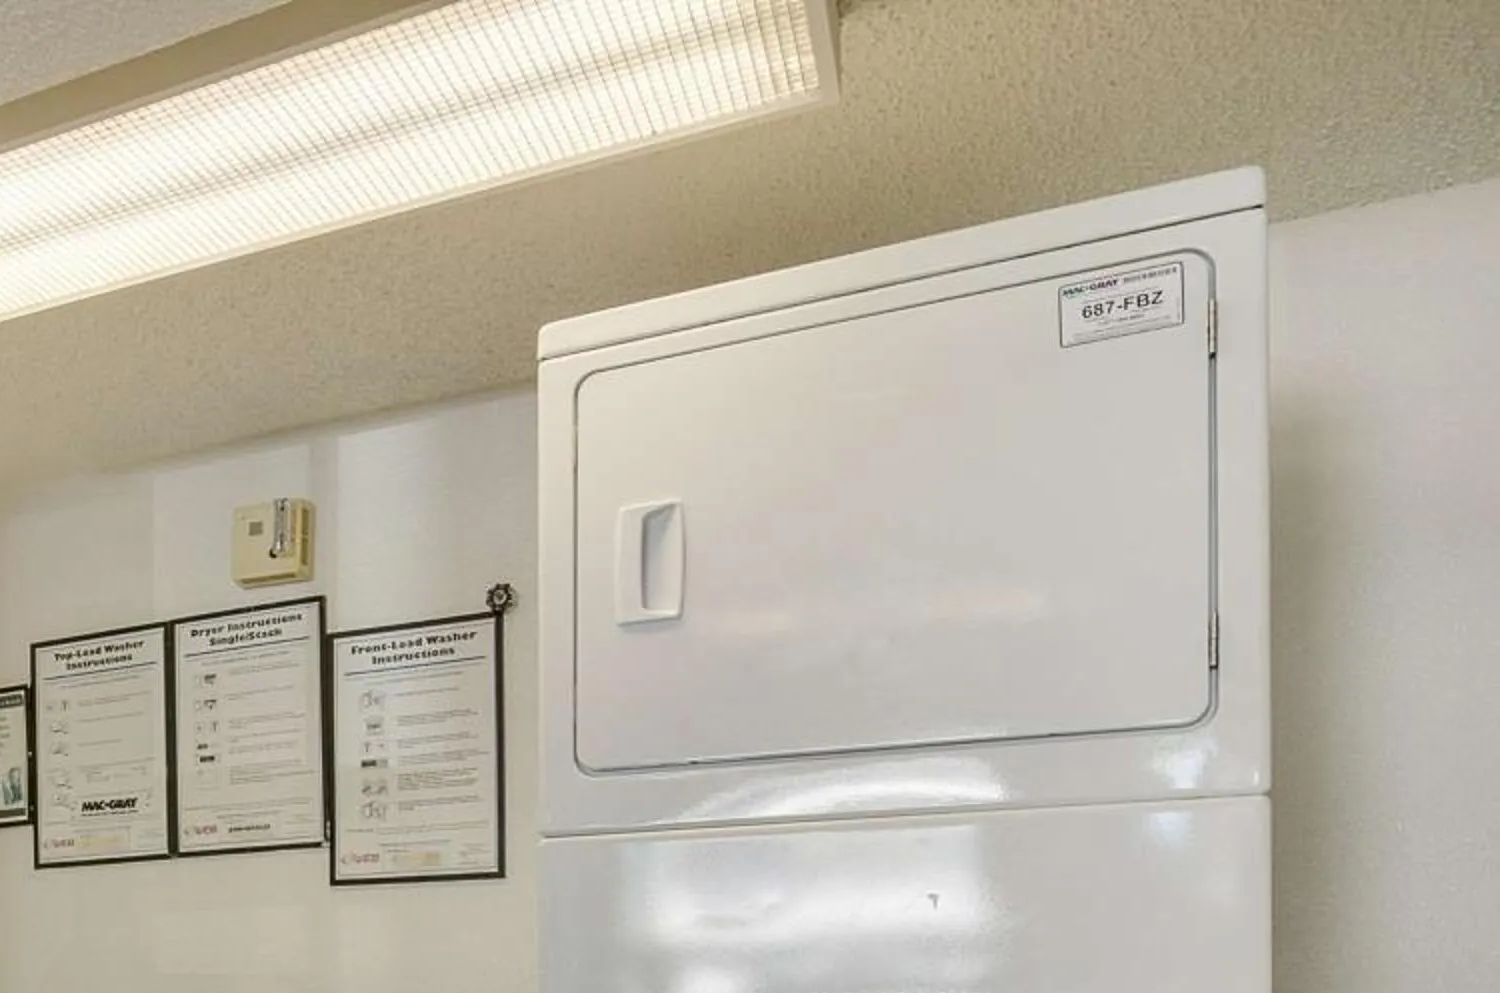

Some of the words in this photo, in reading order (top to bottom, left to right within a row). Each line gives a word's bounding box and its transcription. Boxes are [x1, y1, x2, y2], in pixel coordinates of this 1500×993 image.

[1082, 290, 1163, 319] 687-FBZ
[190, 625, 224, 638] Dryer
[227, 613, 302, 631] Instructions
[104, 640, 144, 653] Washer
[351, 637, 423, 655] Front-Load
[425, 631, 478, 645] Washer
[66, 653, 133, 671] Instructions
[372, 646, 455, 665] Instructions
